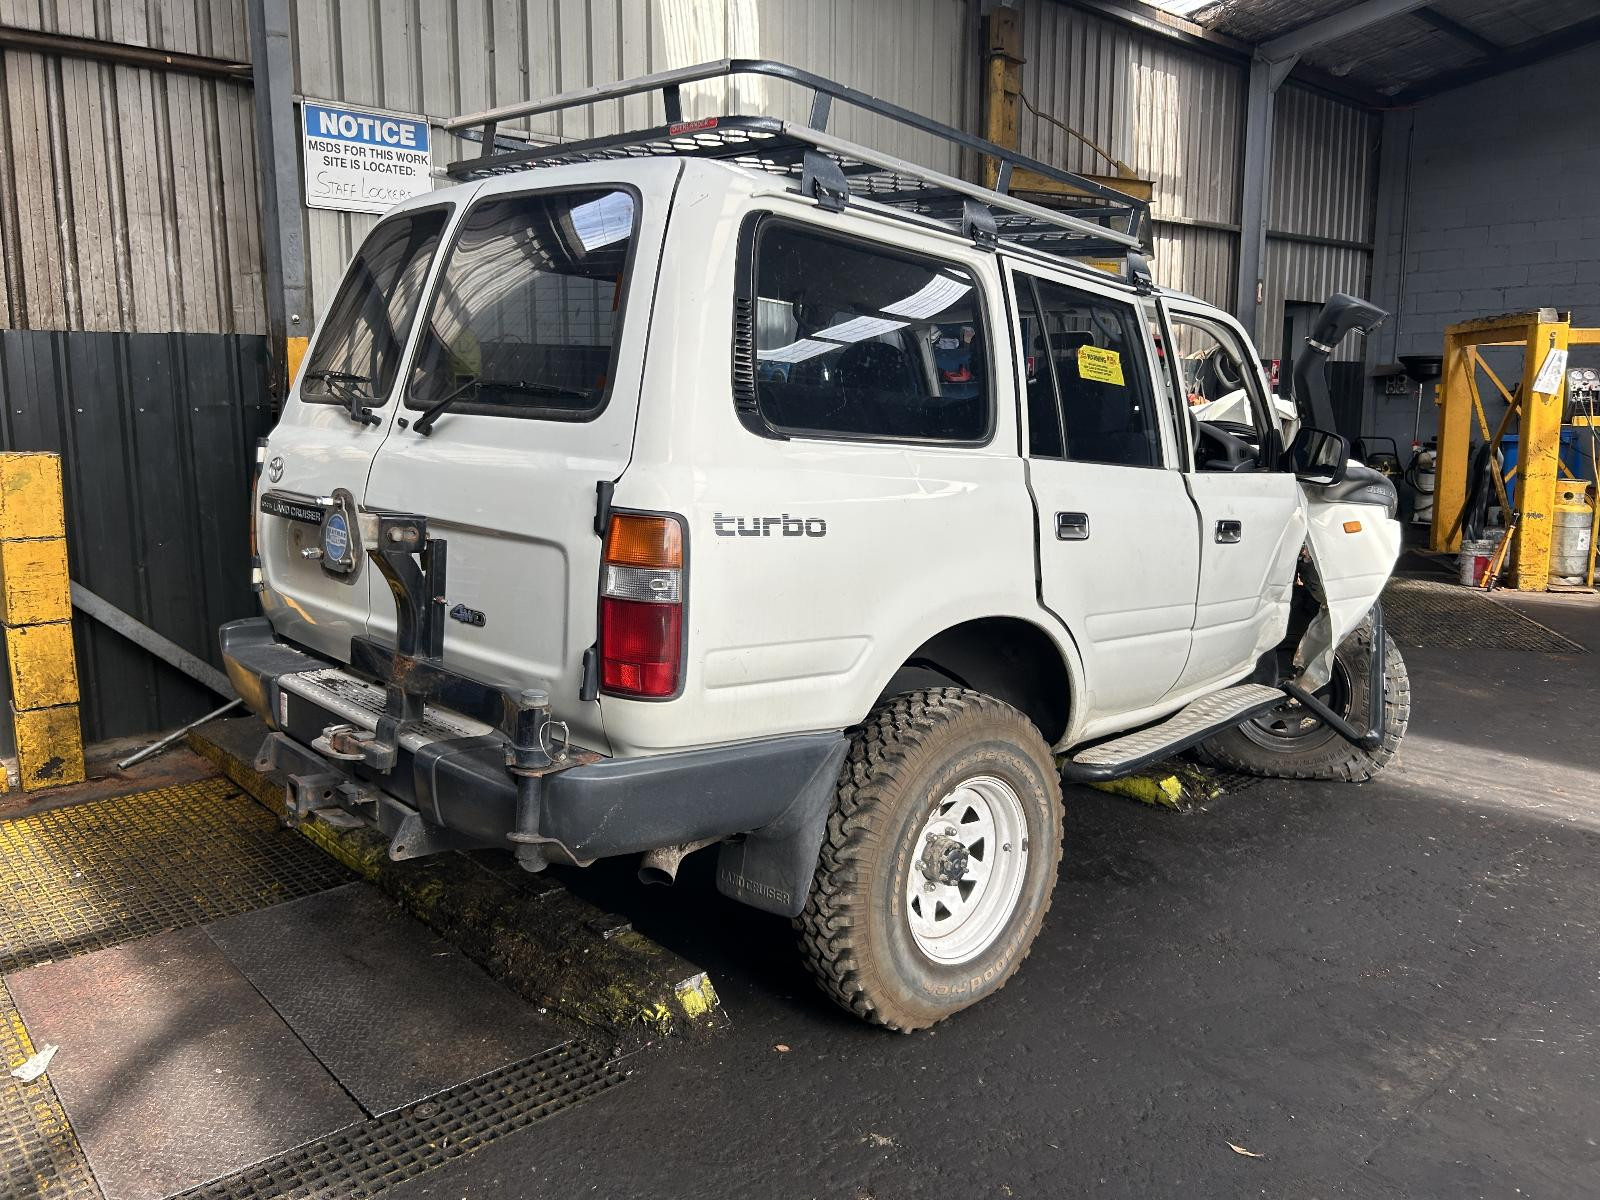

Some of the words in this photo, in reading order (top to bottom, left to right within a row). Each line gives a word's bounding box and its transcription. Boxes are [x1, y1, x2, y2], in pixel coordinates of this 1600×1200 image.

[320, 111, 416, 147] NOTICE
[308, 140, 341, 154] MSDS
[344, 145, 367, 158] FOR
[369, 148, 394, 161] THIS
[396, 152, 429, 166] WORK
[323, 156, 348, 169] SITE
[350, 159, 361, 170] IS
[363, 161, 416, 177] LOCATED:
[273, 503, 290, 515] LAND
[291, 507, 321, 521] CRUISER
[713, 512, 827, 537] turbo
[746, 879, 790, 905] CRUISER
